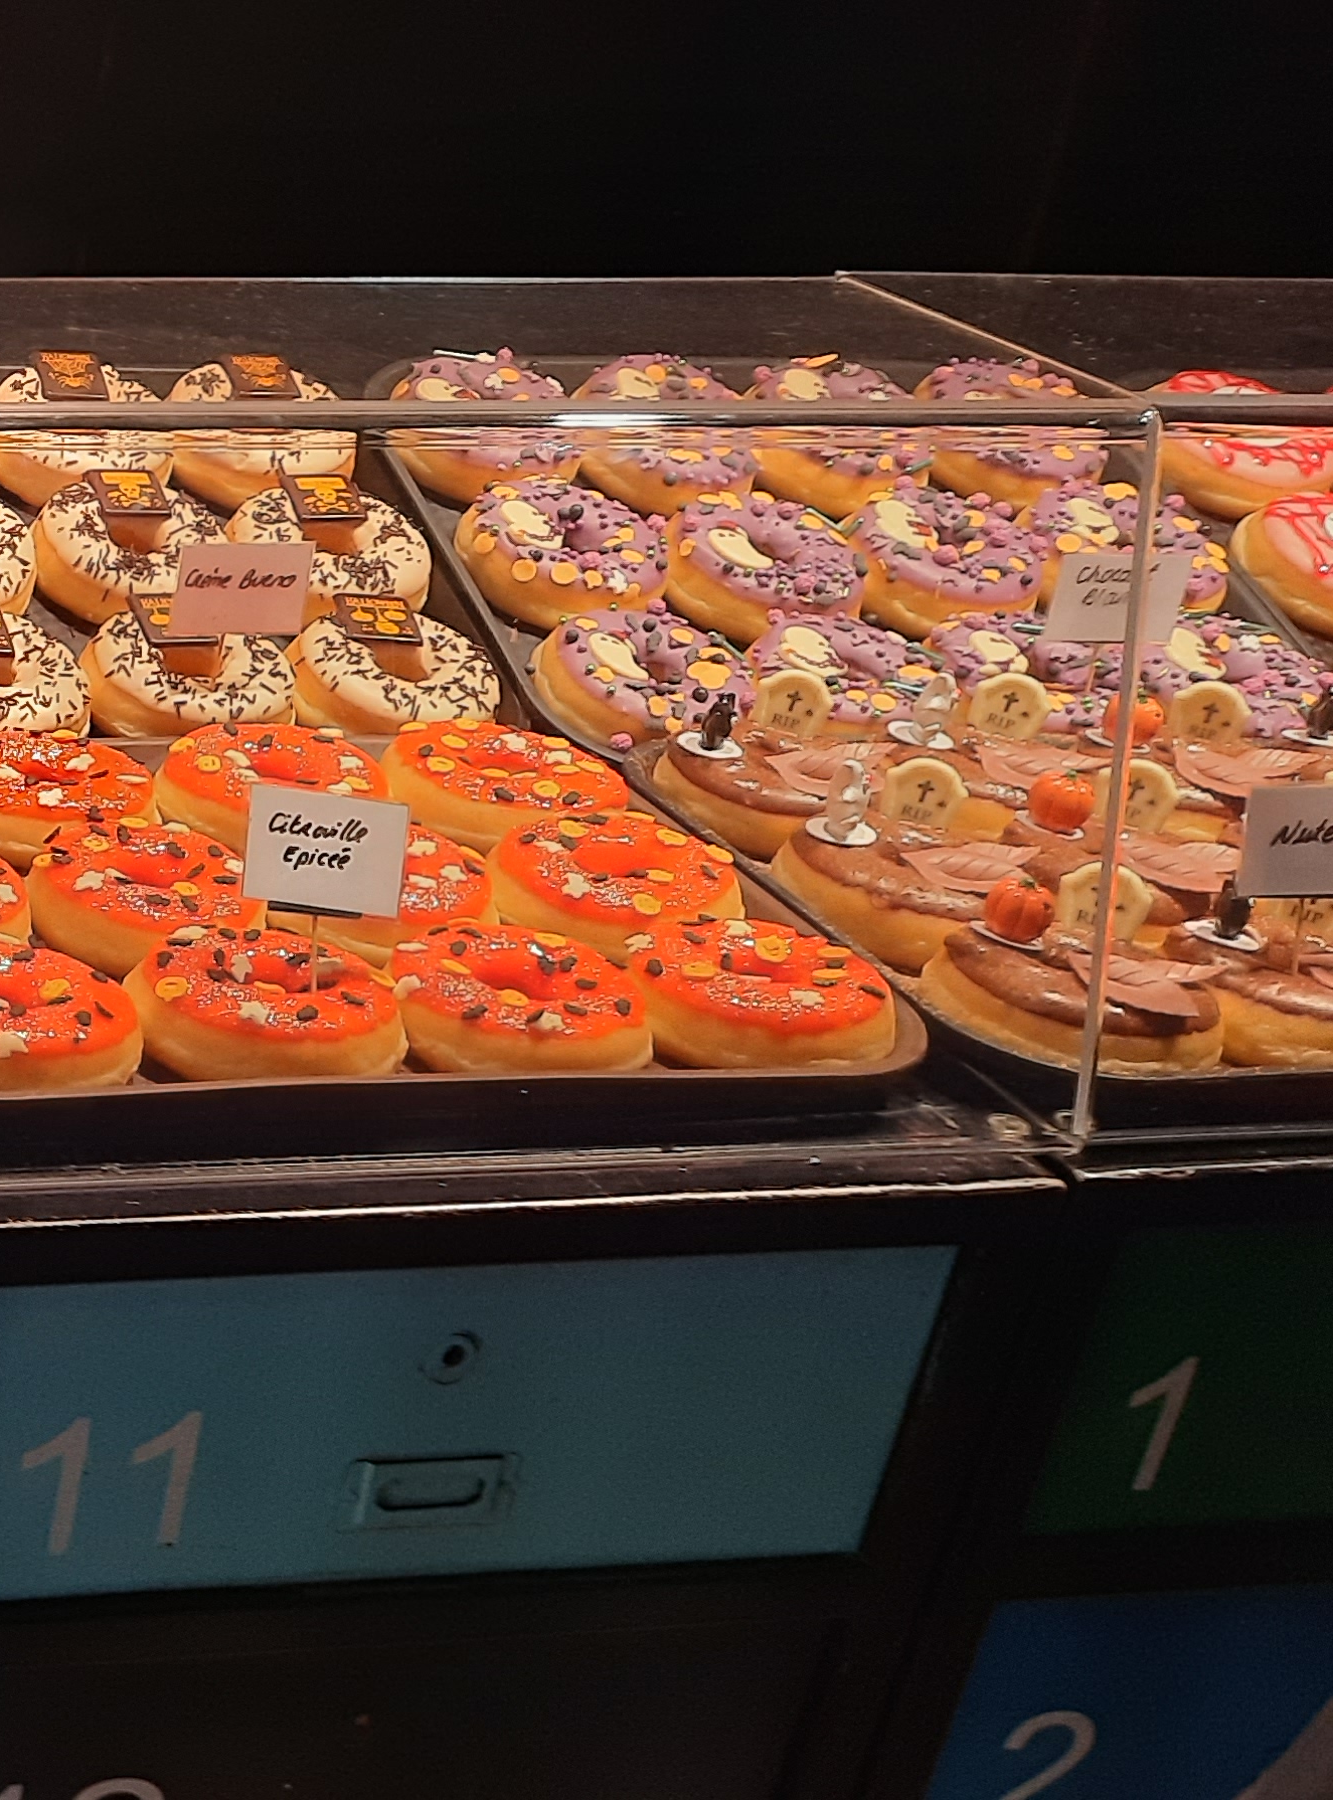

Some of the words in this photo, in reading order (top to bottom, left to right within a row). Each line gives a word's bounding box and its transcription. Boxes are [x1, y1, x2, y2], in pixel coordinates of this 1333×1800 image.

[238, 568, 297, 590] Bueno
[771, 713, 800, 729] RIP
[987, 713, 1015, 729] RIP
[901, 804, 933, 820] RIP
[268, 812, 369, 843] Citrouille
[1130, 1356, 1200, 1490] 1
[22, 1410, 203, 1555] 11
